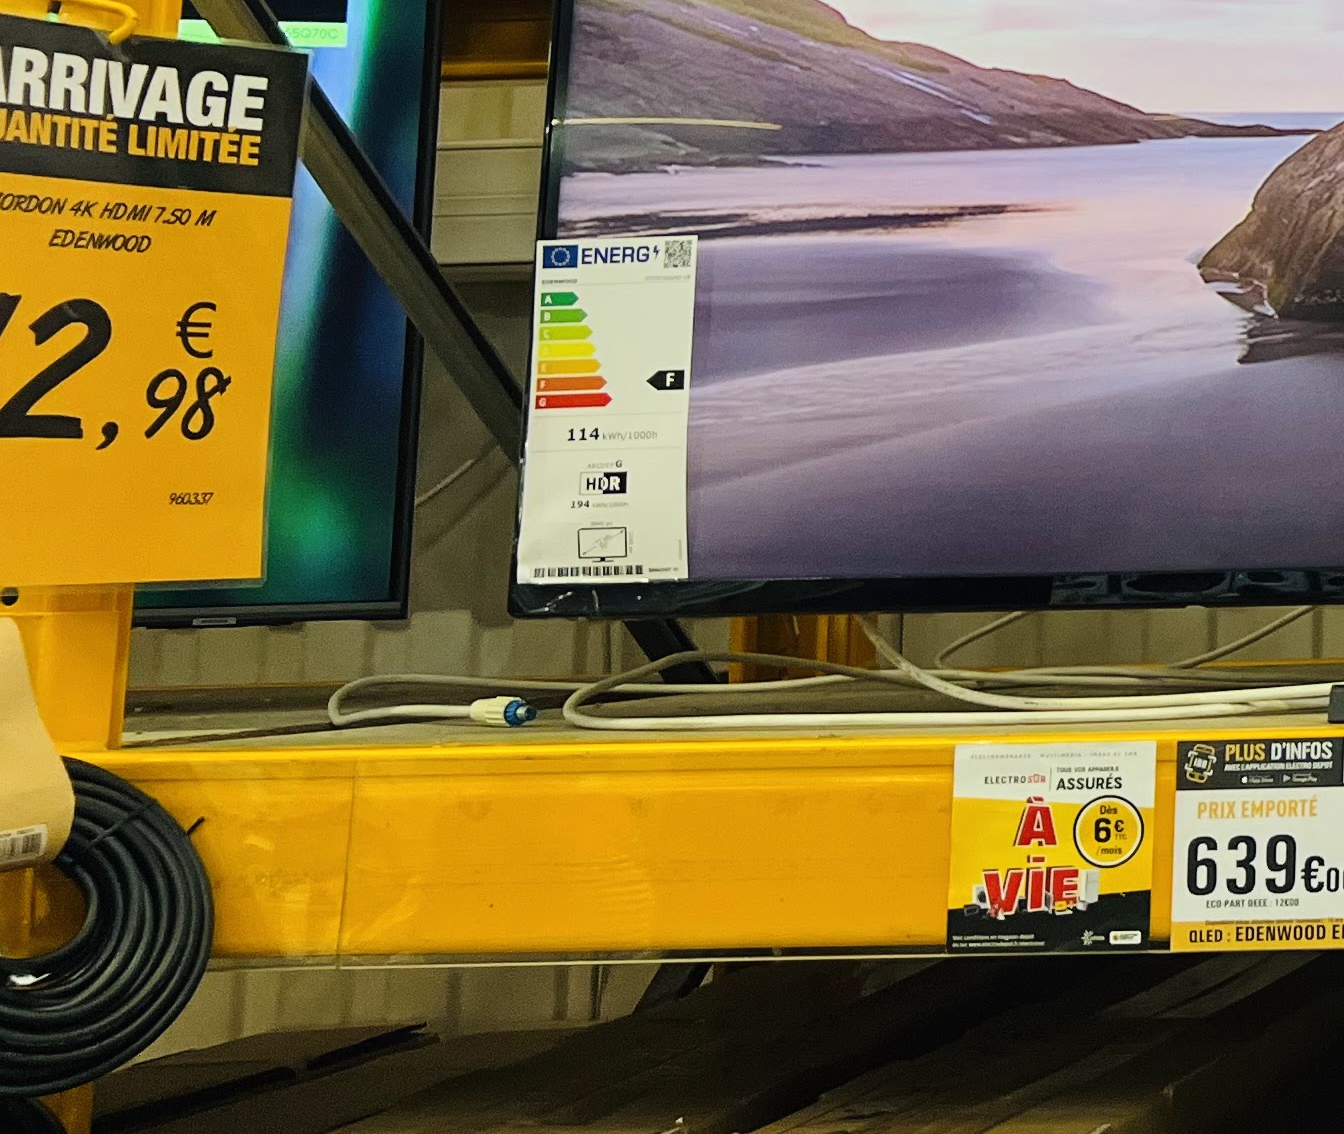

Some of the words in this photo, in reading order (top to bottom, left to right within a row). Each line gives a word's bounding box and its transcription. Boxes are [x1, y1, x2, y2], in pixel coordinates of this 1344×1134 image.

[0, 45, 269, 131] RRIVAGE
[128, 124, 262, 166] LIMITÉE
[69, 200, 98, 218] 4K
[100, 202, 152, 222] HDMI
[194, 209, 217, 227] M
[48, 228, 152, 254] EDENWOOD
[582, 245, 650, 265] ENERG
[543, 294, 553, 305] A
[175, 301, 217, 359] €
[665, 372, 676, 388] F
[567, 427, 600, 442] 114
[602, 429, 658, 441] kWh/1000h
[585, 475, 620, 491] HDR
[570, 499, 590, 509] 194
[1225, 742, 1266, 762] PLUS
[1271, 741, 1333, 761] D'INFOS
[1056, 772, 1122, 791] ASSURÉS
[1099, 804, 1118, 815] Dès
[1197, 801, 1236, 821] PRIX
[1241, 794, 1318, 818] EMPORTÉ
[1013, 796, 1058, 847] À
[1094, 817, 1111, 843] 6
[1189, 929, 1222, 943] QLED
[1235, 924, 1326, 942] EDENWOOD
